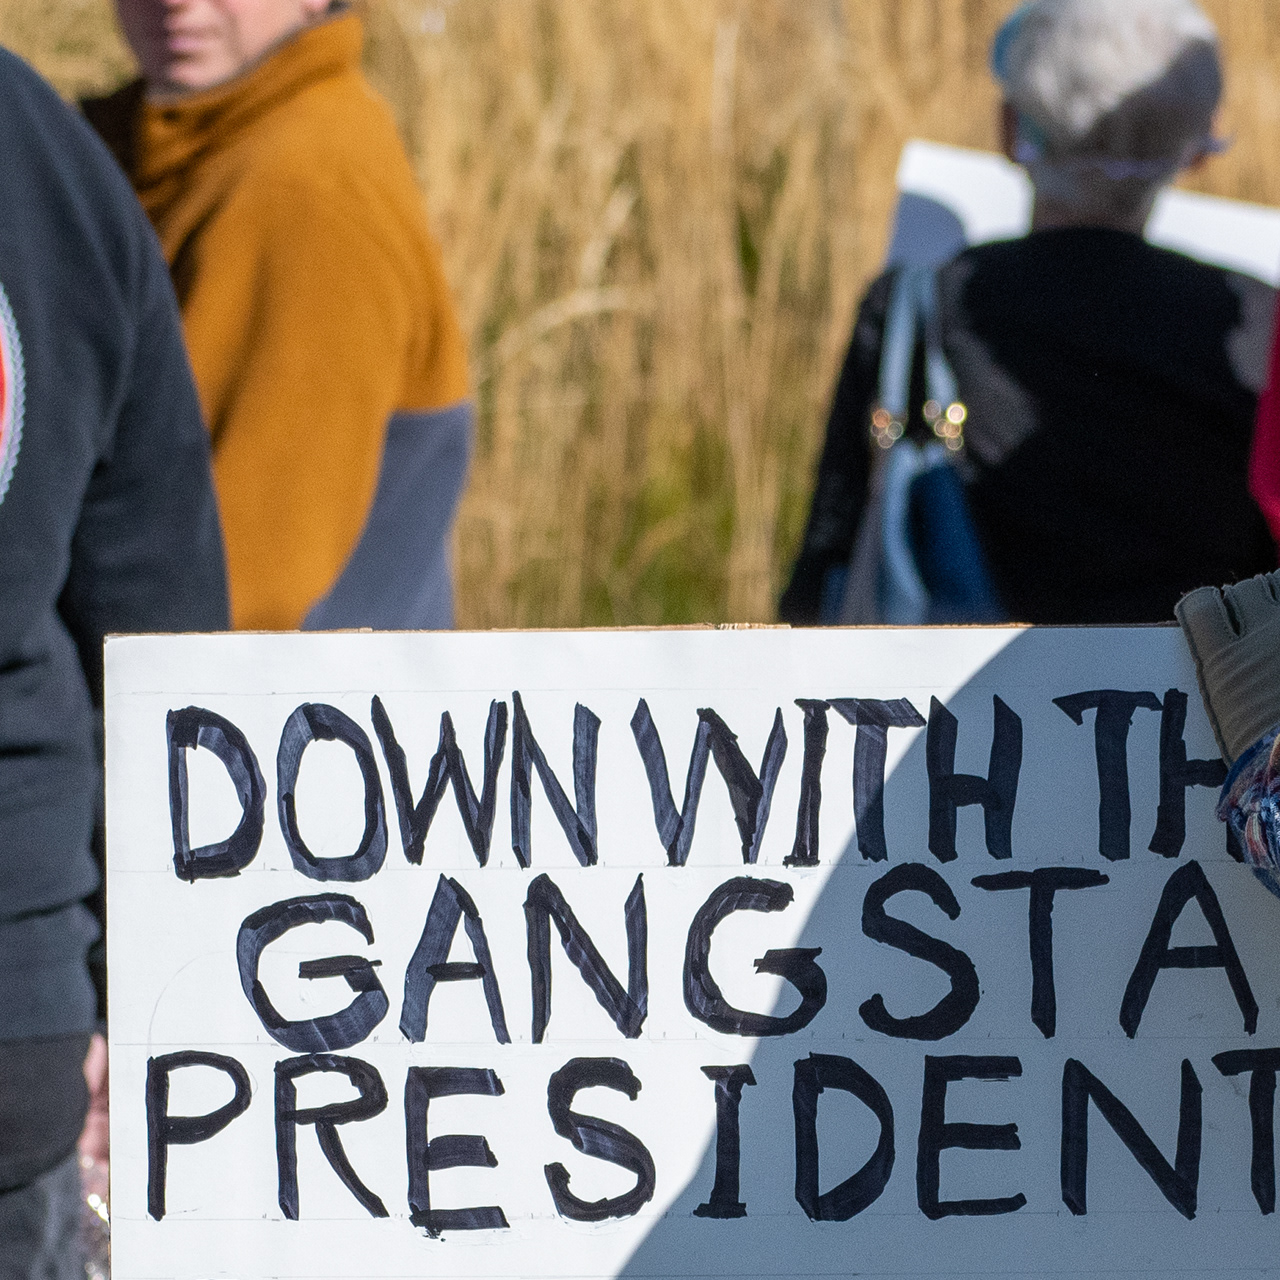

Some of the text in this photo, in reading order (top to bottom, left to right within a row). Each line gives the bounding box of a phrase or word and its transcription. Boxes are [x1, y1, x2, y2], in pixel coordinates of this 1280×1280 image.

[166, 687, 1244, 883] DOWN WITH TH
[236, 860, 1259, 1053] GANGSTA
